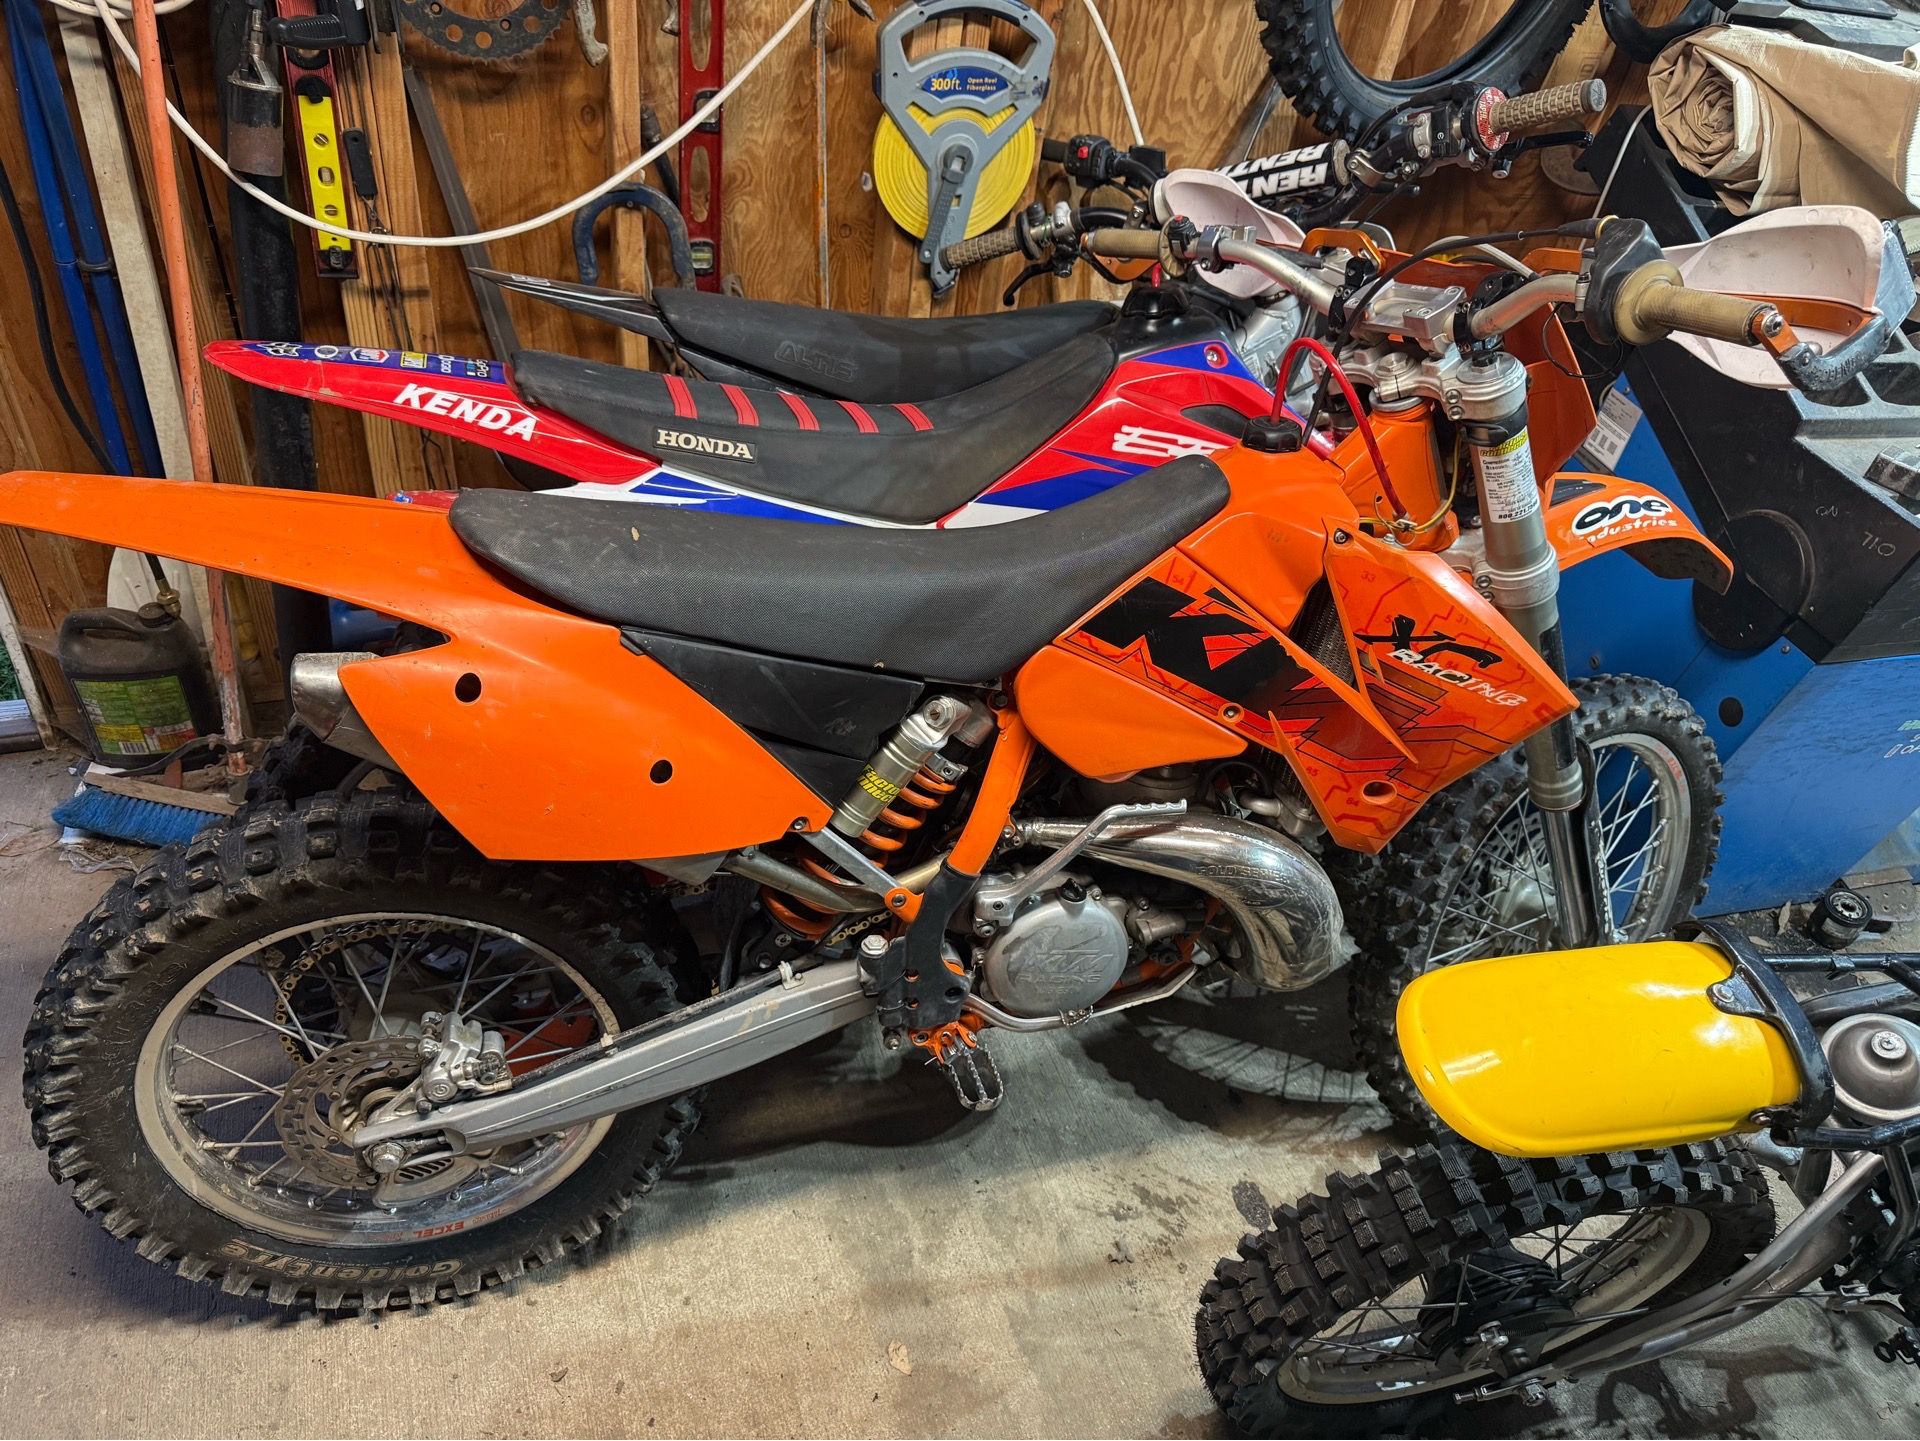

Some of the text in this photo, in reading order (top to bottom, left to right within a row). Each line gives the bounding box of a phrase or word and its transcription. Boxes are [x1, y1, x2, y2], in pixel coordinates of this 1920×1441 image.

[930, 77, 962, 91] 300ft.
[966, 84, 997, 92] Fiberglass
[393, 382, 538, 442] KENDA
[656, 429, 754, 460] HONDA
[1572, 495, 1672, 535] one
[1585, 517, 1678, 543] ndustries
[1386, 648, 1528, 708] RACING
[412, 1220, 466, 1240] EXCEL
[219, 1243, 466, 1283] Goldentyre
